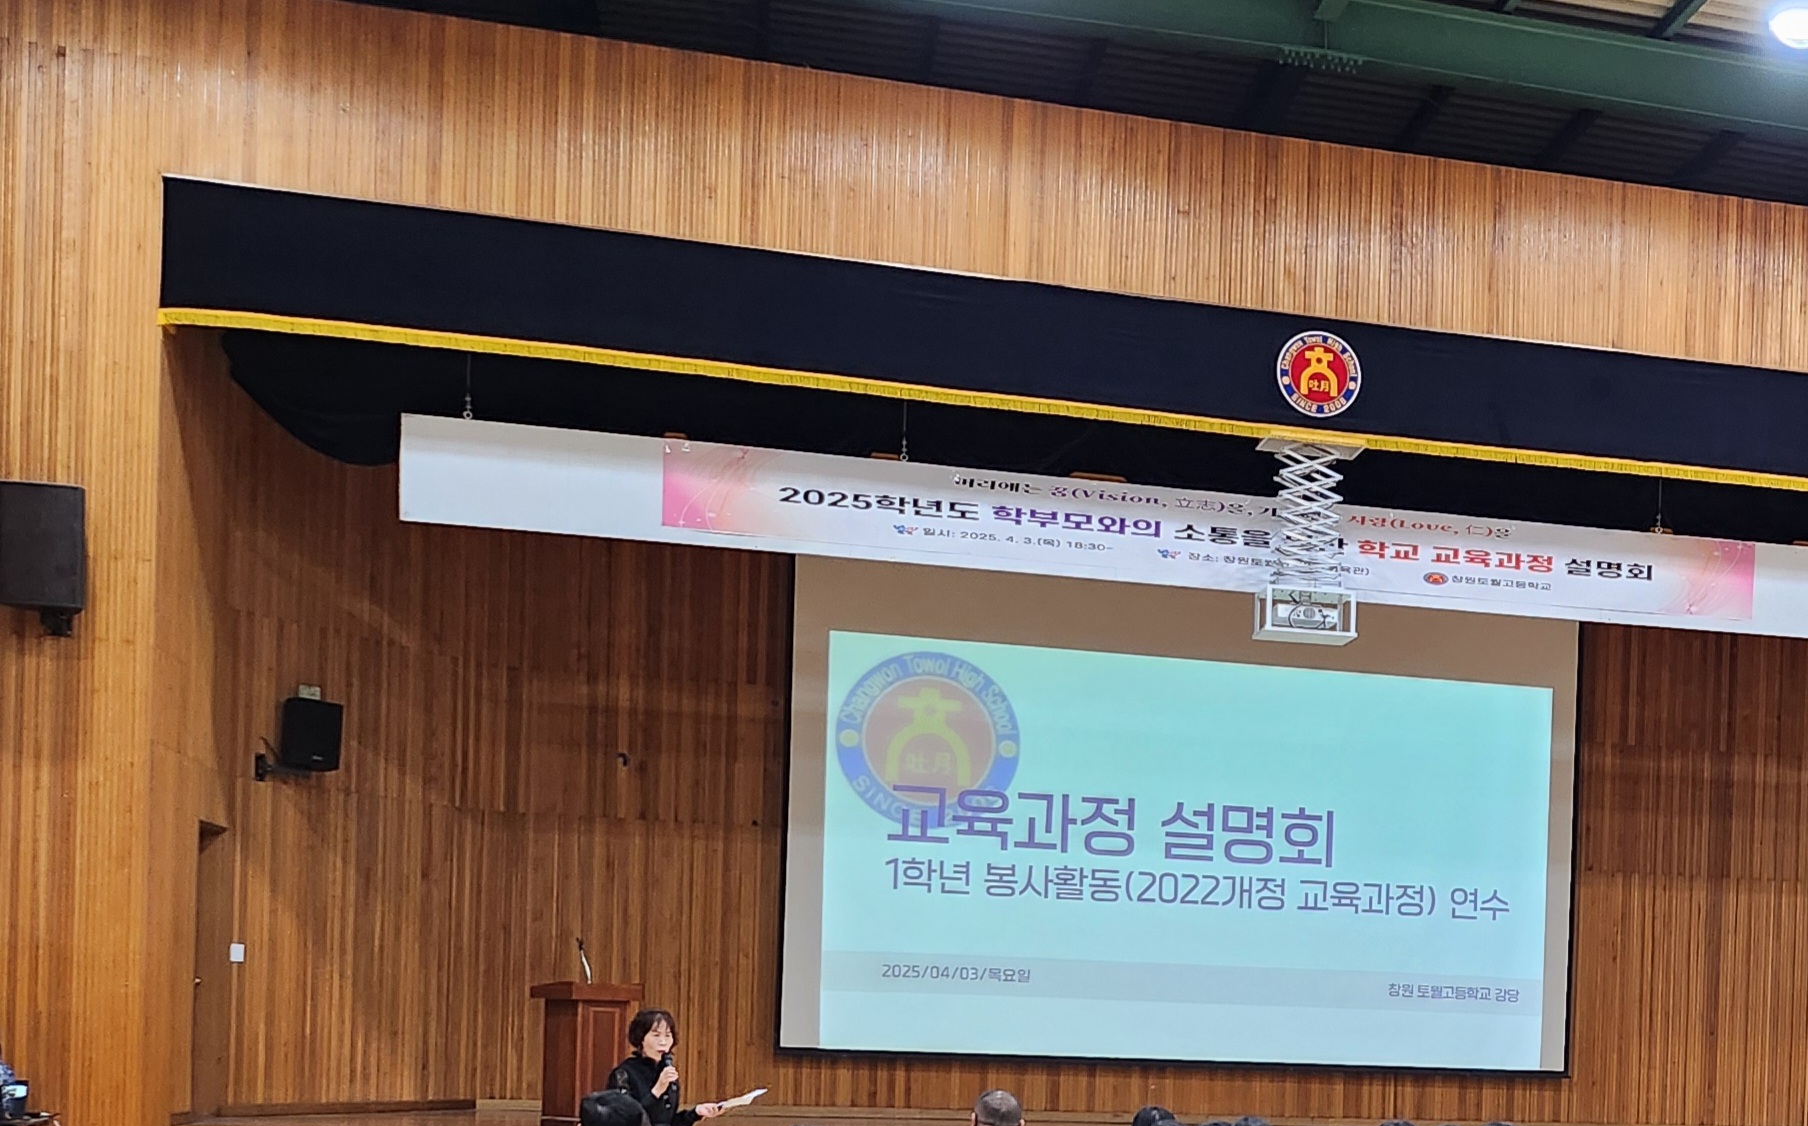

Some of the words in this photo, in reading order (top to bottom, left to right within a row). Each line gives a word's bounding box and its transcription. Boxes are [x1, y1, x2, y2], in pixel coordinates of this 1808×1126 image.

[1291, 393, 1317, 413] SINCE
[778, 486, 980, 521] 2025학년도
[991, 505, 1163, 539] 학부모와의
[1173, 523, 1274, 549] 소통을
[1356, 539, 1420, 561] 학교
[1430, 546, 1553, 574] 교육과정
[1564, 558, 1653, 581] 설명회
[922, 527, 955, 539] 일시:
[960, 530, 1001, 543] 2025.
[1005, 535, 1018, 544] 4.
[1347, 515, 1459, 536] 사랑(Love,
[1188, 551, 1219, 562] 장소:
[1451, 574, 1551, 591] 창원토월고등학교
[840, 663, 901, 724] Changwon
[902, 654, 949, 676] Towol
[952, 661, 986, 692] High
[982, 683, 1018, 735] School
[887, 784, 1136, 857] 교육과정
[1161, 801, 1335, 868] 설명회
[885, 857, 971, 895] 1학년
[984, 862, 1286, 911] 봉사활동(2022개정
[1296, 879, 1436, 917] 교육과정)
[1450, 887, 1510, 921] 연수
[881, 964, 1031, 983] 2025/04/03/목요일
[1388, 983, 1414, 998] 창원
[1417, 984, 1491, 1000] 토월고등학교
[1495, 987, 1520, 1003] 강당
